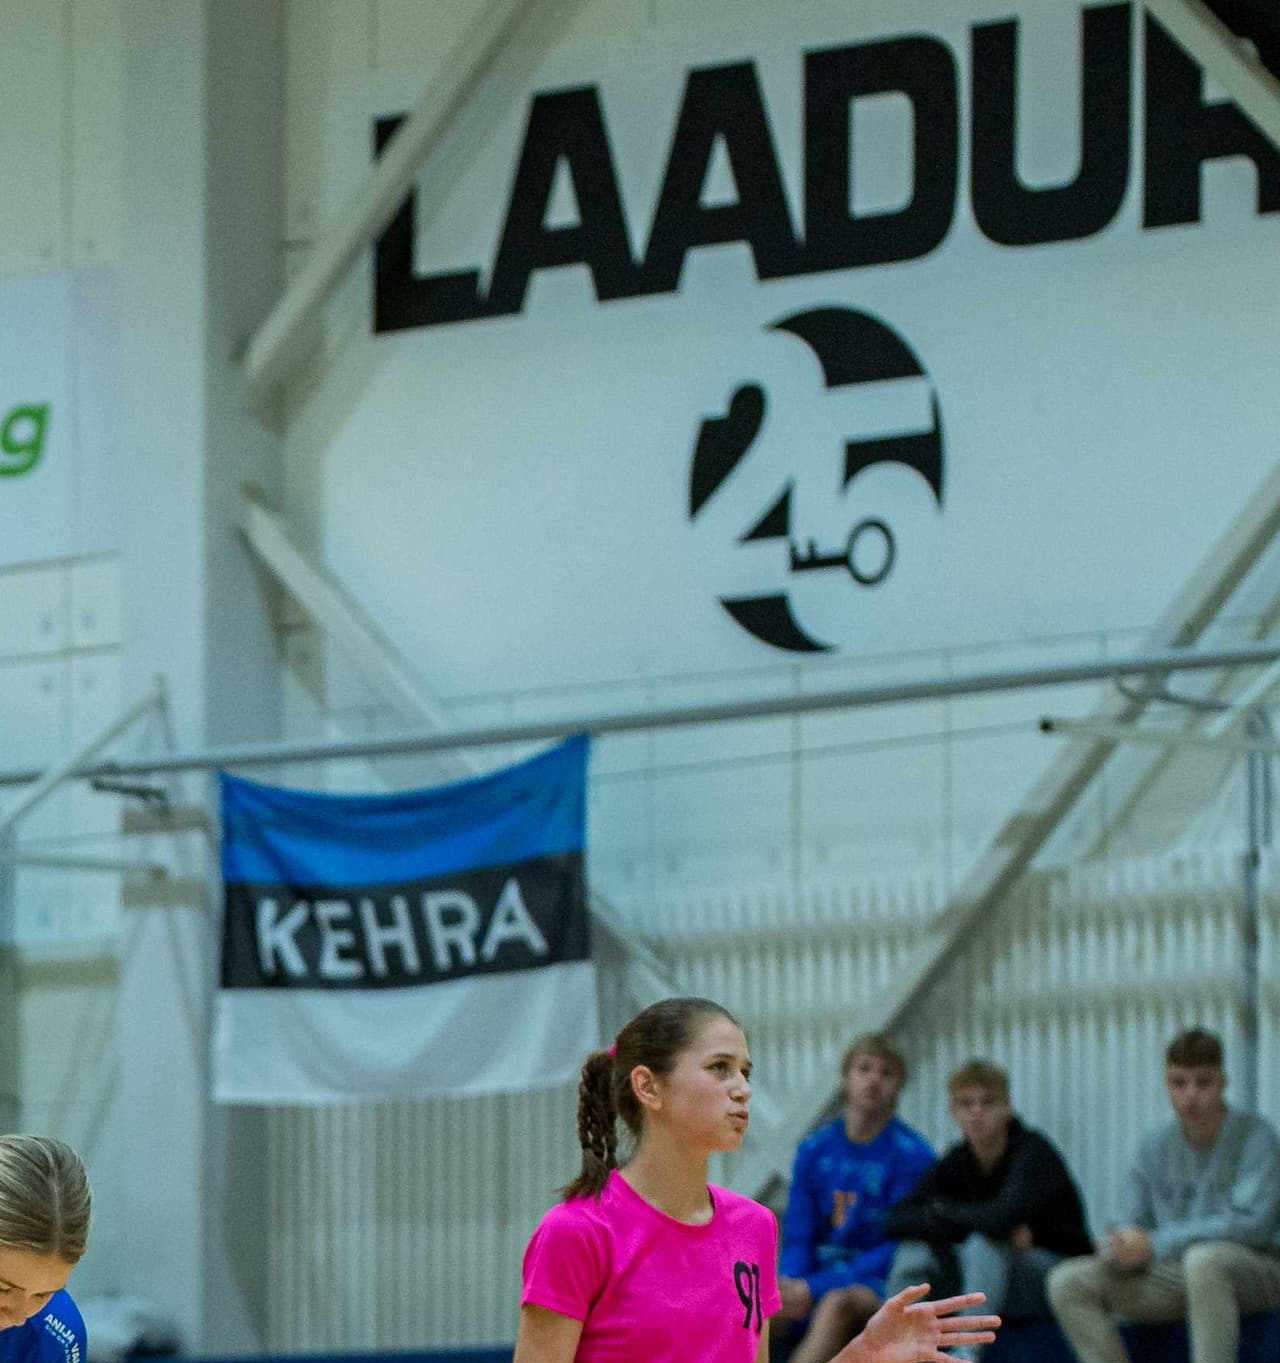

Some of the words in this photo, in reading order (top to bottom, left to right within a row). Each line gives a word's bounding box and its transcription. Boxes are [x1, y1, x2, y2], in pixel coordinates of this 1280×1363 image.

[255, 878, 548, 979] KEHRA
[44, 1313, 76, 1344] ANIJA
[734, 1261, 763, 1335] 91
